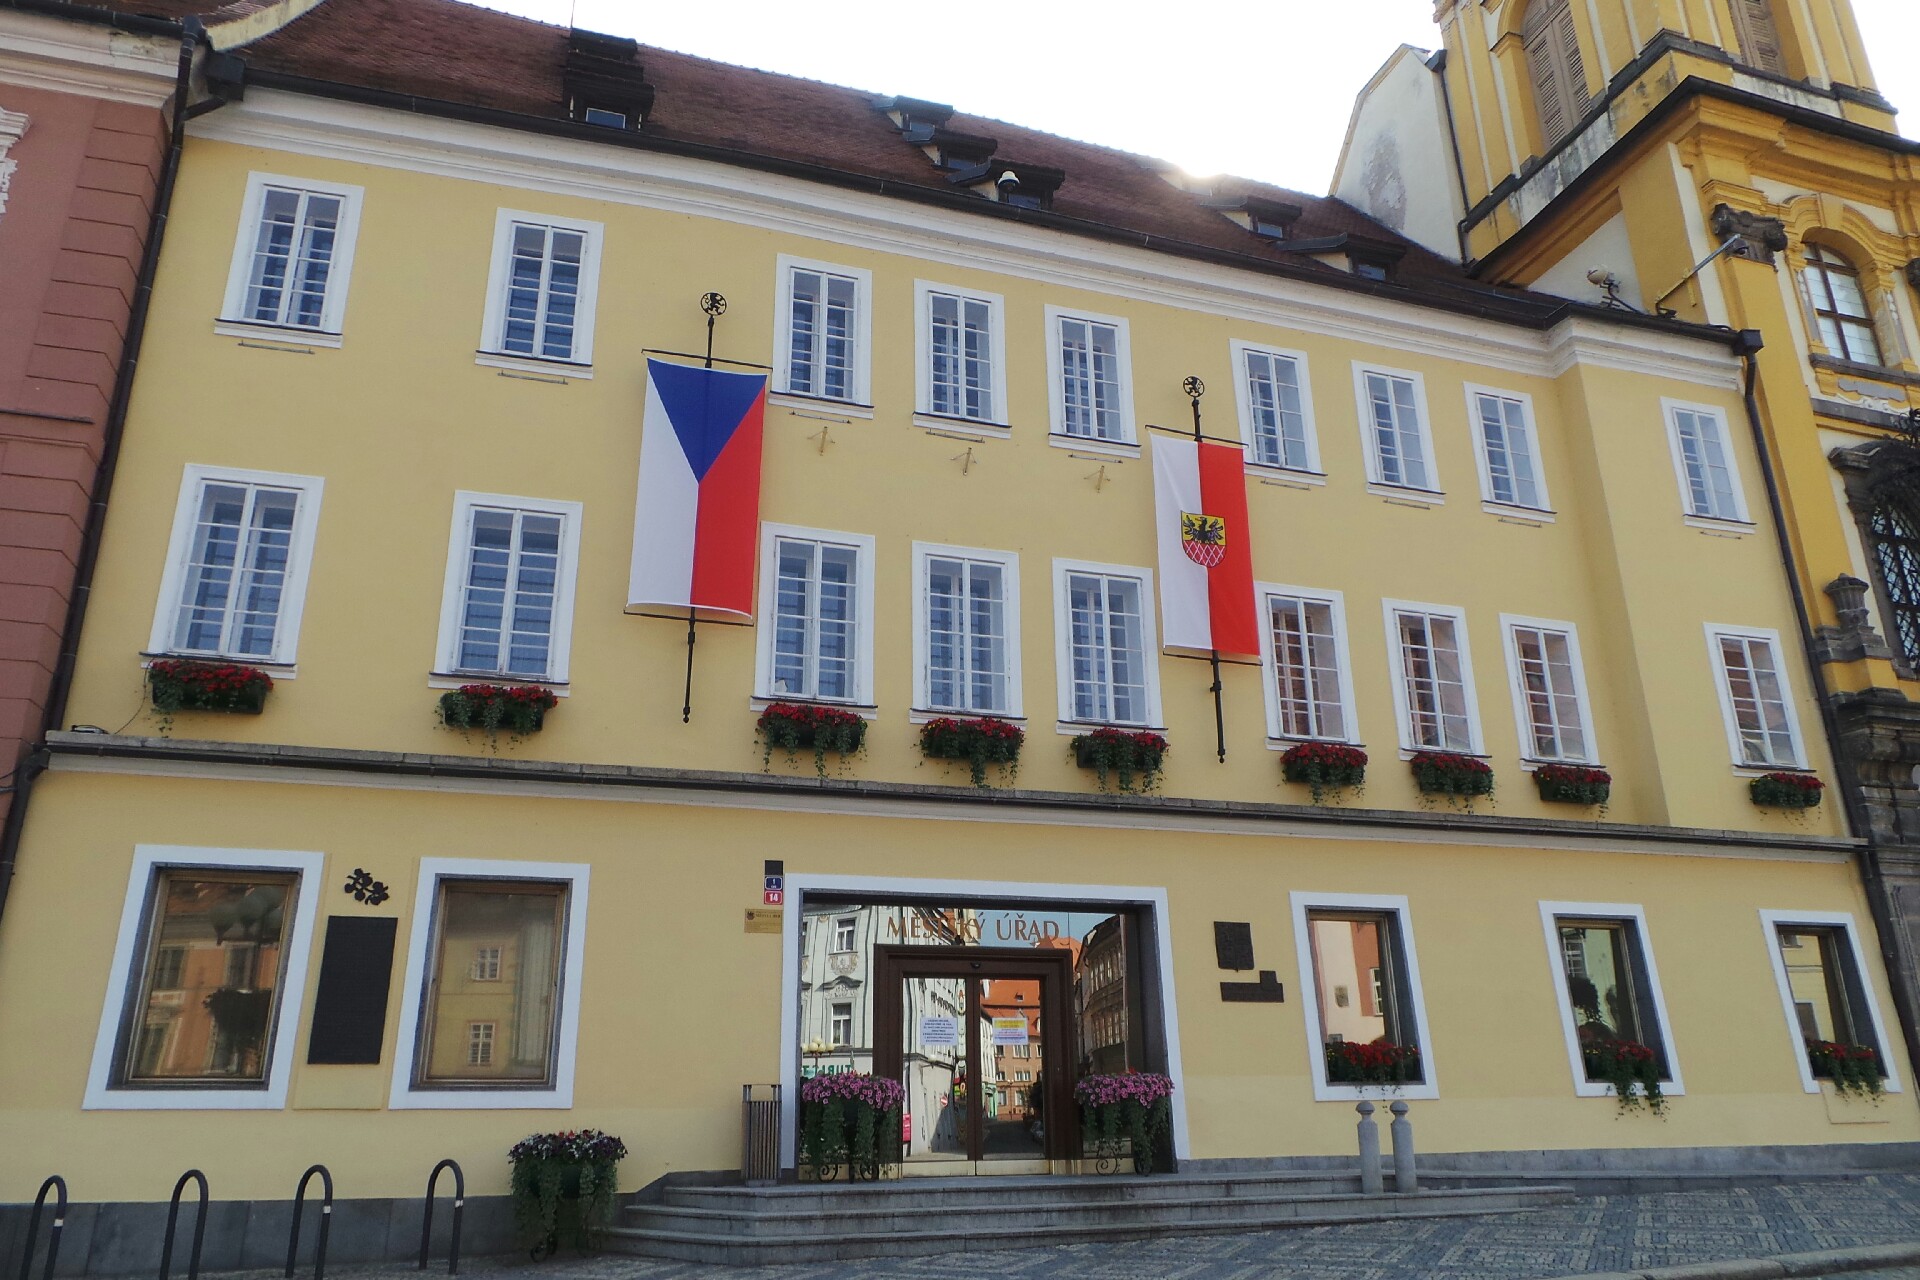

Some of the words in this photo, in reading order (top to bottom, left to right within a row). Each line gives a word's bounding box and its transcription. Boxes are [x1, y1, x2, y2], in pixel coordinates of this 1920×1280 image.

[769, 893, 779, 902] 14
[886, 911, 986, 940] MĚSTSKÝ
[996, 912, 1060, 941] ÚŘAD
